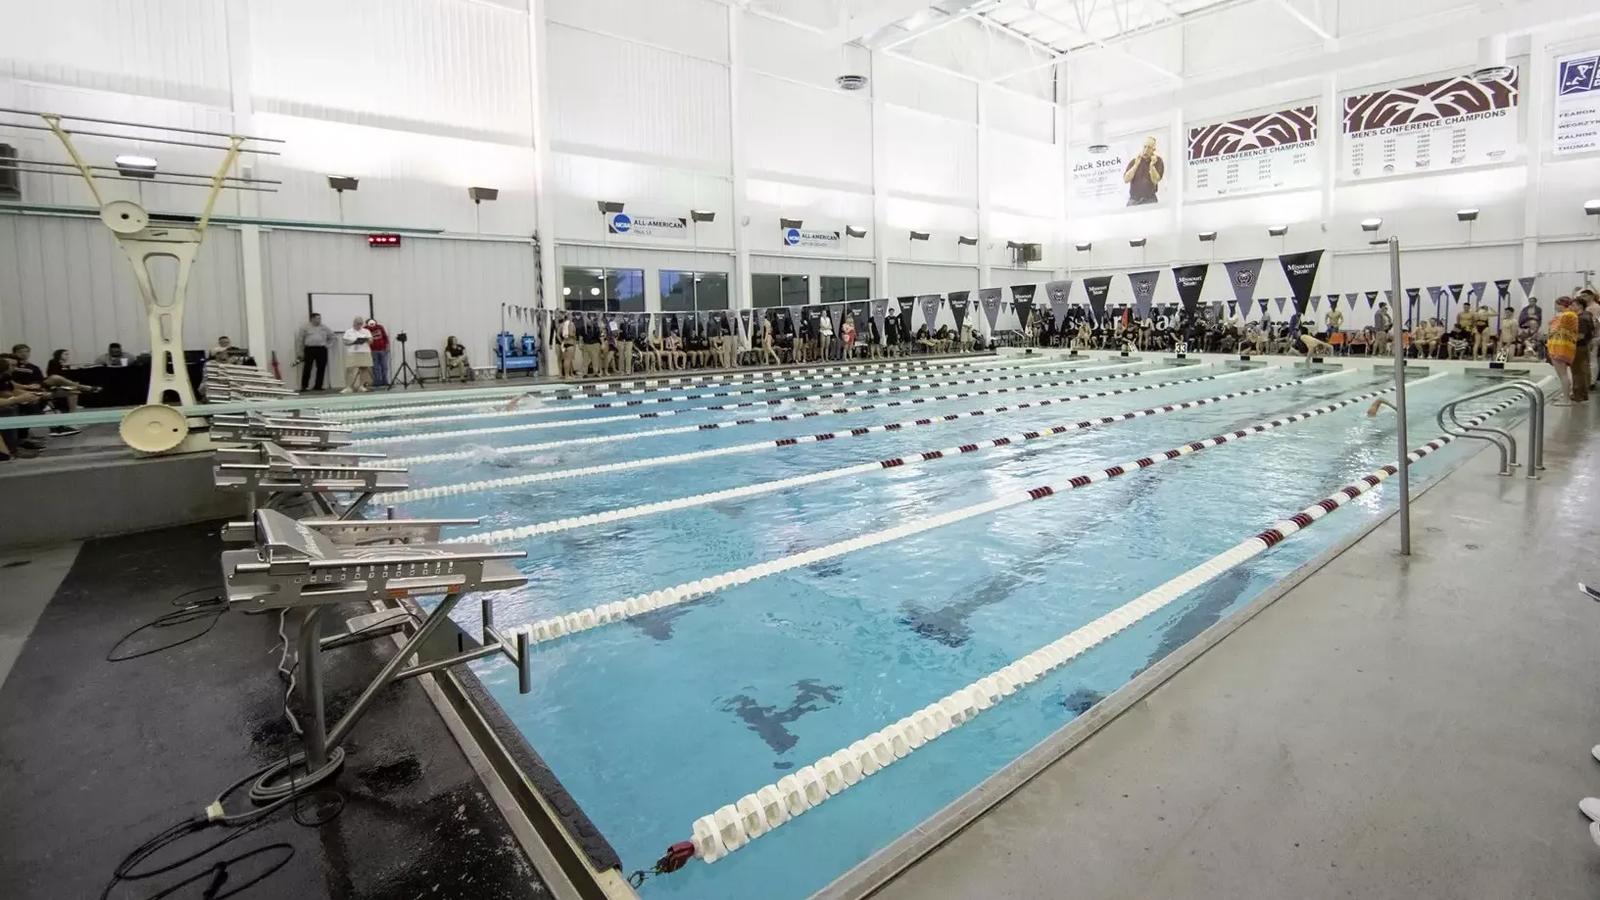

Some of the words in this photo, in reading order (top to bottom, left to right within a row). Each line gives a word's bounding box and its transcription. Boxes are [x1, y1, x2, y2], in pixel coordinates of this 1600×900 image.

[1351, 130, 1378, 139] MEN'S
[1380, 119, 1442, 135] CONFERENCE
[1445, 109, 1507, 125] CHAMPIONS
[1073, 162, 1094, 172] Jack
[1096, 156, 1122, 168] Steck
[1189, 157, 1220, 166] WOMEN'S
[1221, 149, 1268, 161] CONFERENCE
[1270, 140, 1315, 153] CHAMPIONS
